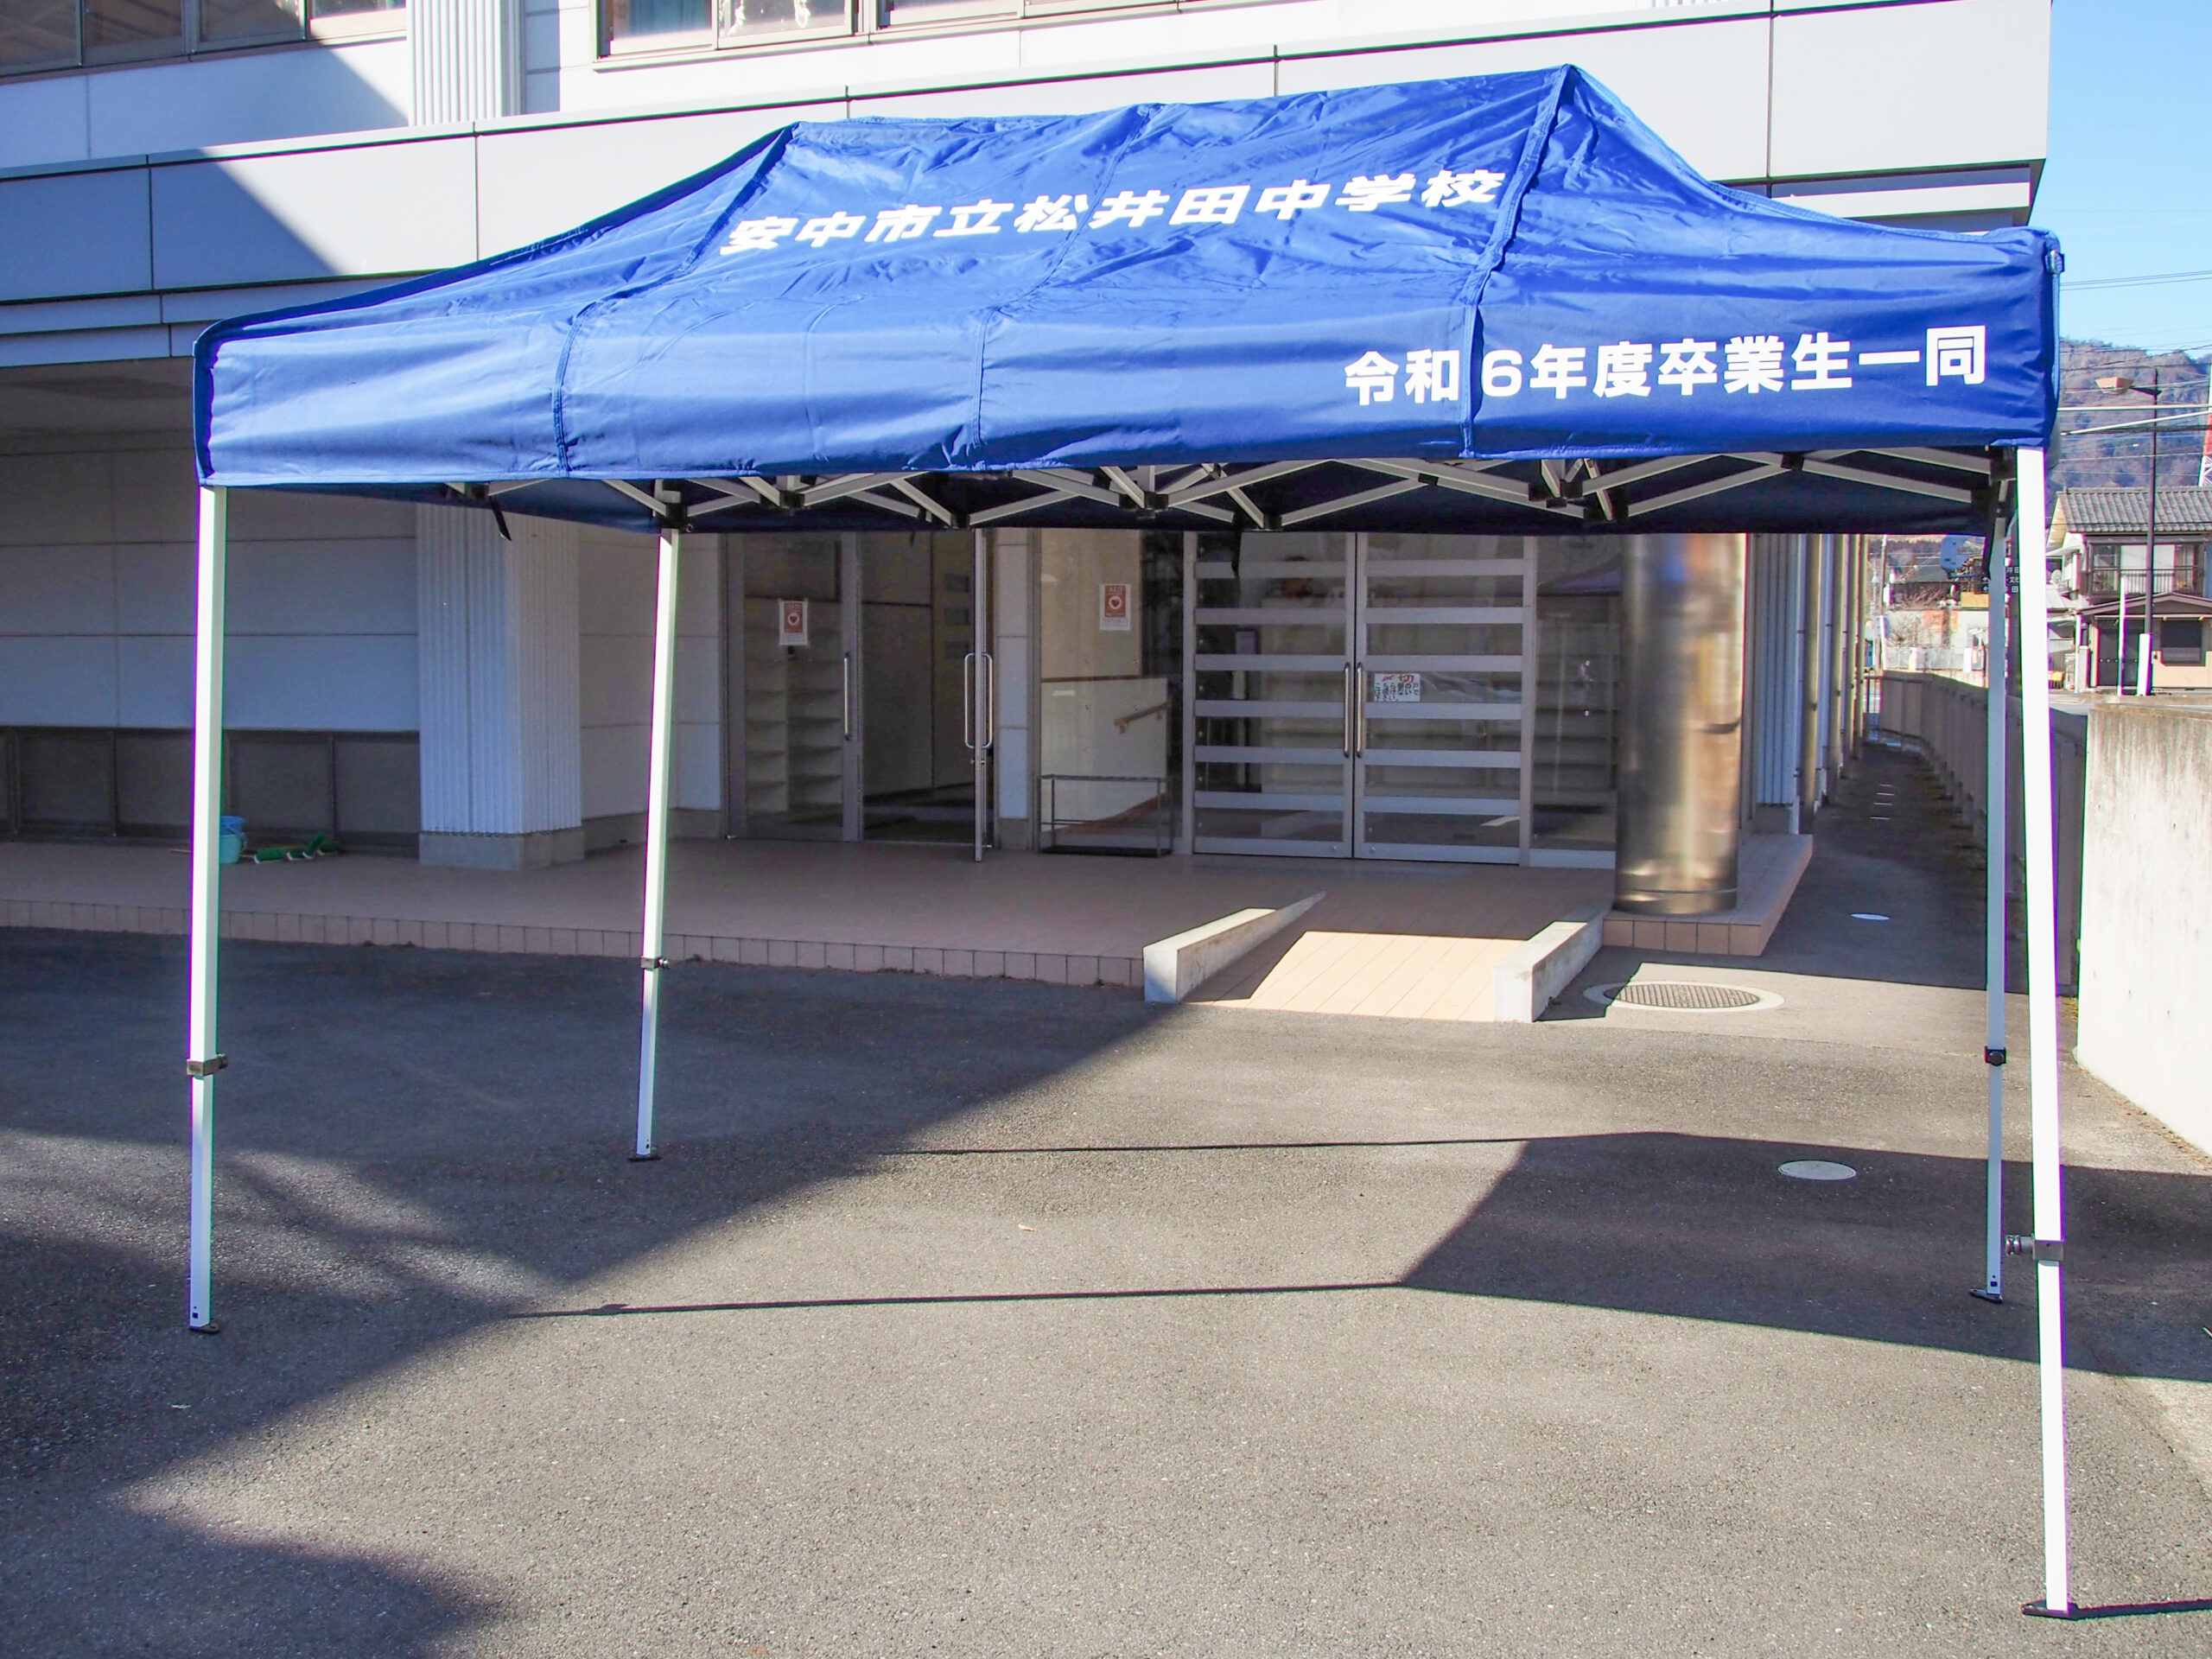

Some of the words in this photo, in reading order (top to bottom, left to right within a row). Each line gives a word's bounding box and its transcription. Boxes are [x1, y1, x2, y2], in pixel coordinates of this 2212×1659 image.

[721, 168, 1505, 256] 安中市立松井田中学校
[1344, 325, 1986, 405] 令和6年度卒業生一同
